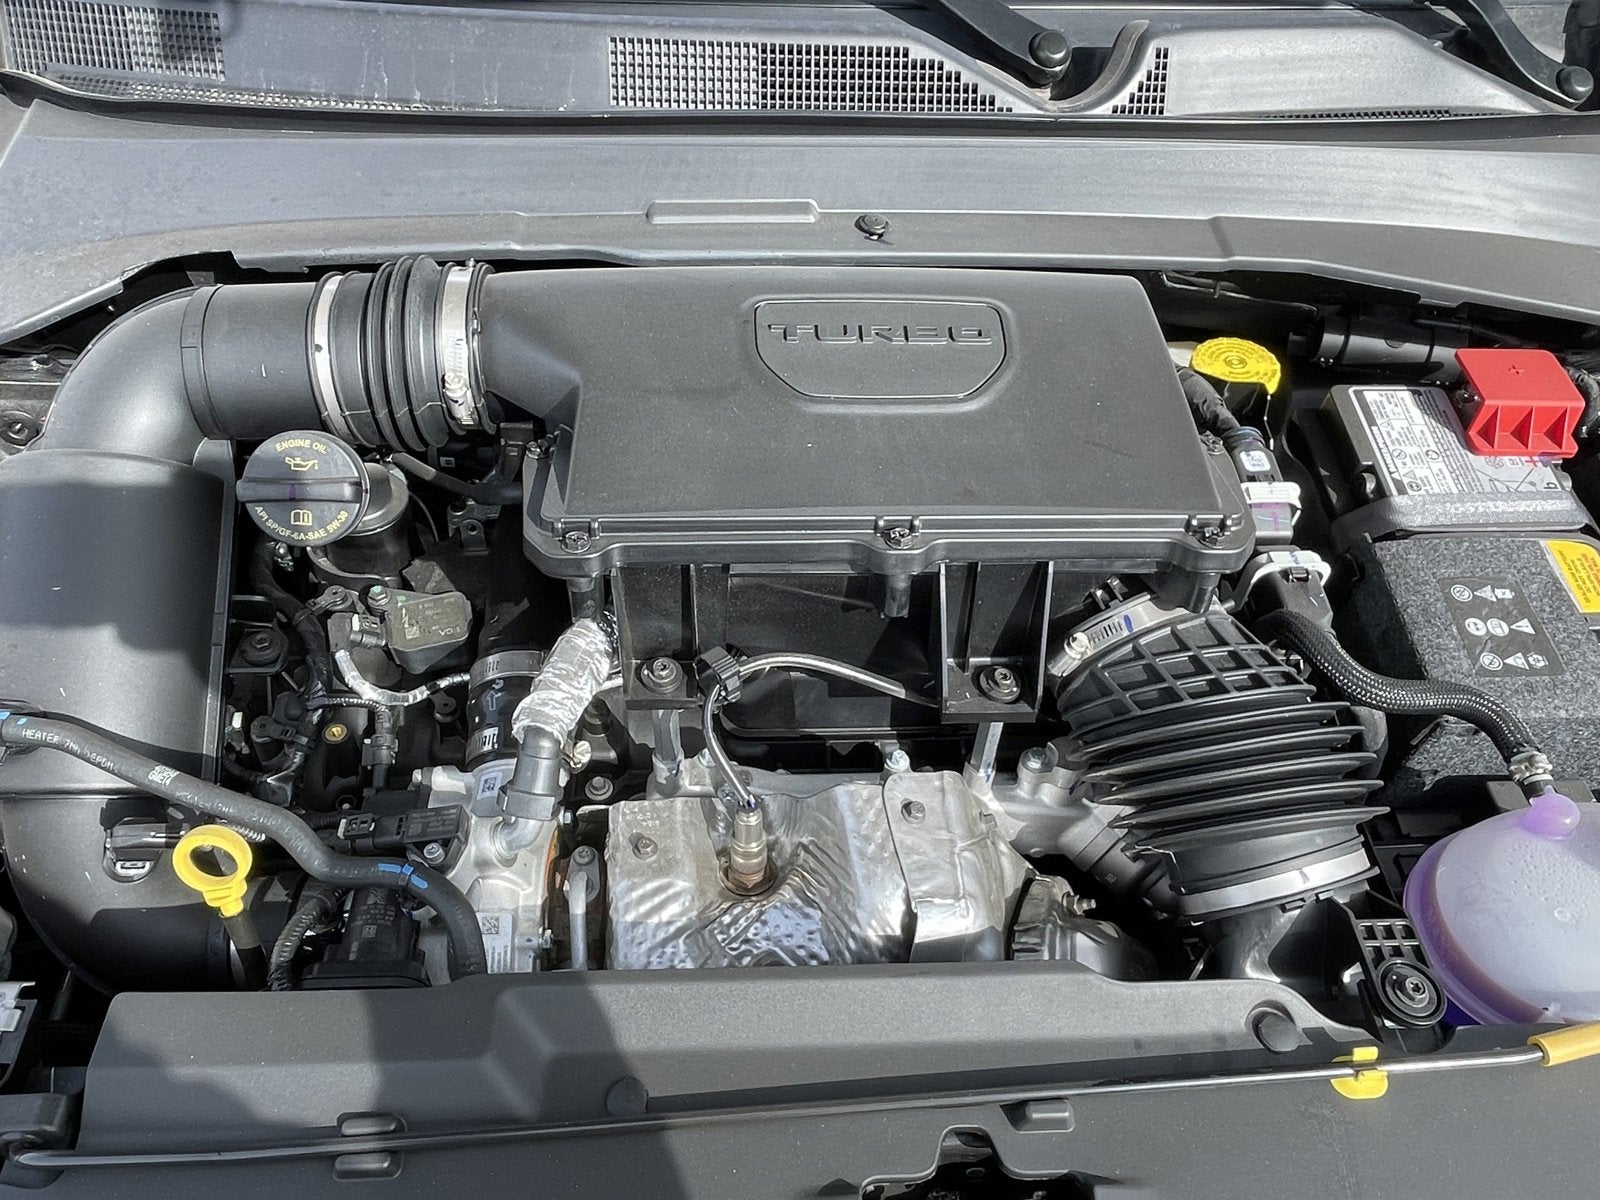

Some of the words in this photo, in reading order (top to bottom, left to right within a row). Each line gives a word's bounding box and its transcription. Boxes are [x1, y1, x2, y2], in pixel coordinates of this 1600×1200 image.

[767, 324, 992, 344] TURBO
[275, 439, 311, 452] ENGINE
[312, 441, 328, 455] OIL
[254, 506, 269, 524] API
